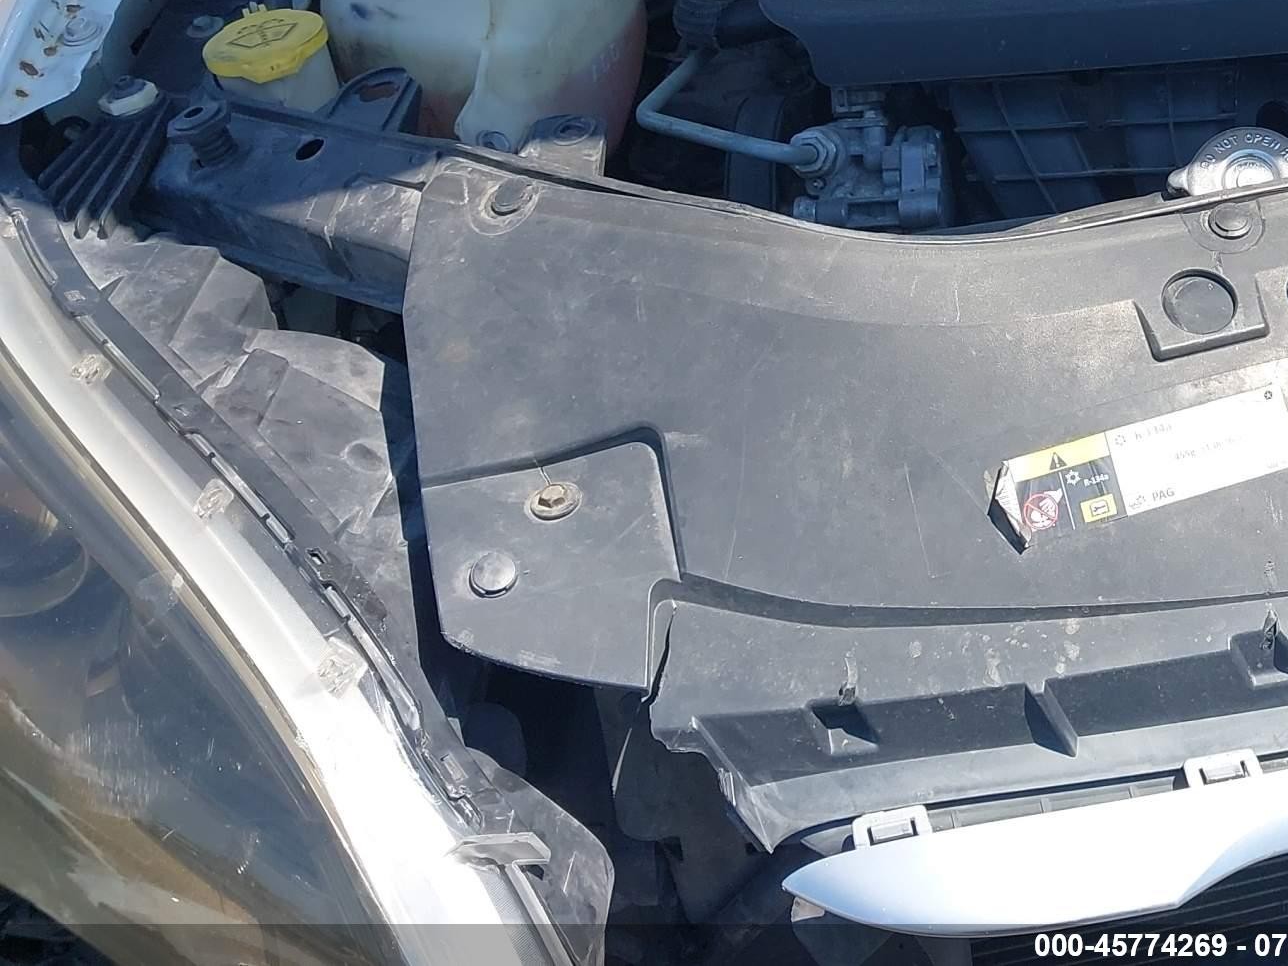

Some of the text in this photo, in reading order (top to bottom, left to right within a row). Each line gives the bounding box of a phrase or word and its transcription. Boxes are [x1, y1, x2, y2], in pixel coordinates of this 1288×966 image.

[1214, 135, 1239, 153] NOT
[1244, 133, 1281, 150] OPEN
[1083, 473, 1110, 487] R-134a
[1151, 487, 1175, 502] PAG
